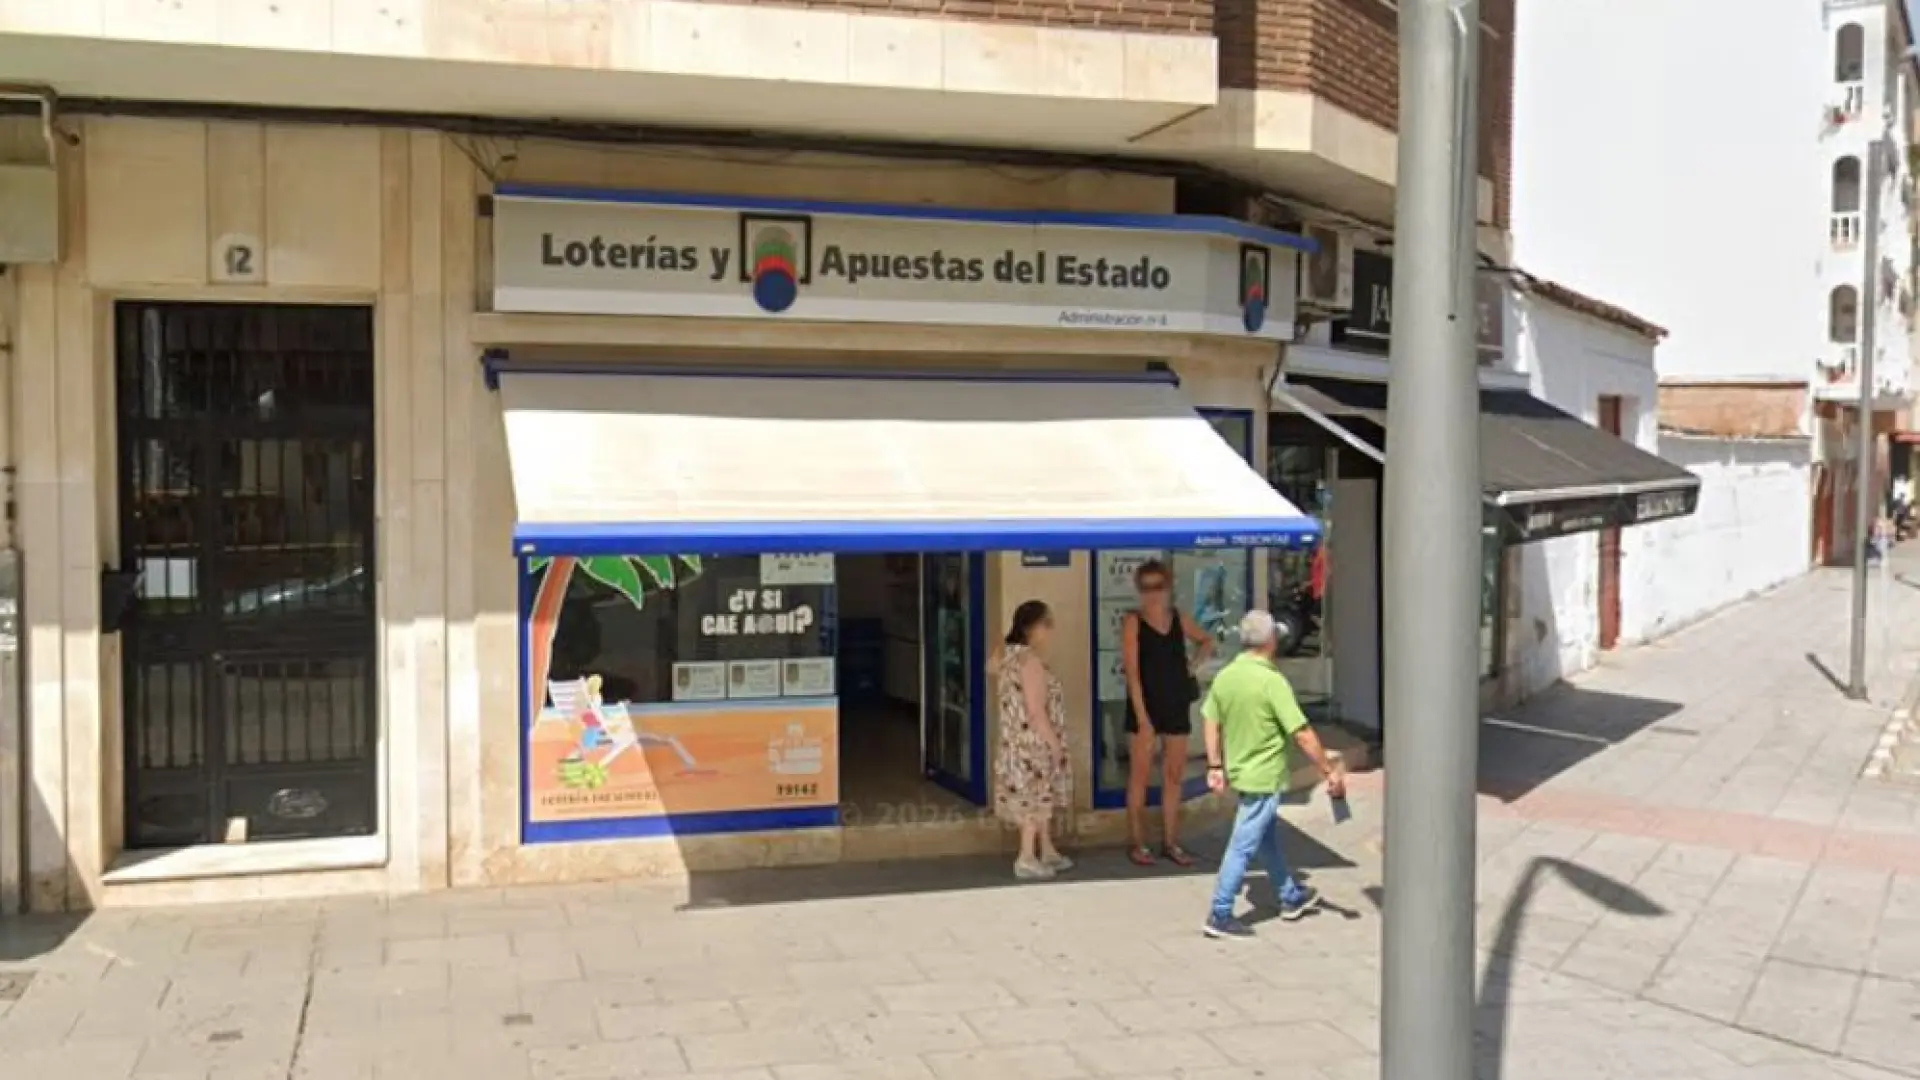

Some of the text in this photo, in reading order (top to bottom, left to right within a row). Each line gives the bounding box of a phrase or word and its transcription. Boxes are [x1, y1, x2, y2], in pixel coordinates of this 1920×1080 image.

[224, 245, 253, 274] 12
[541, 233, 1170, 290] Loterías y Apuestas del Estado
[761, 588, 782, 610] SI
[701, 613, 739, 636] CAE
